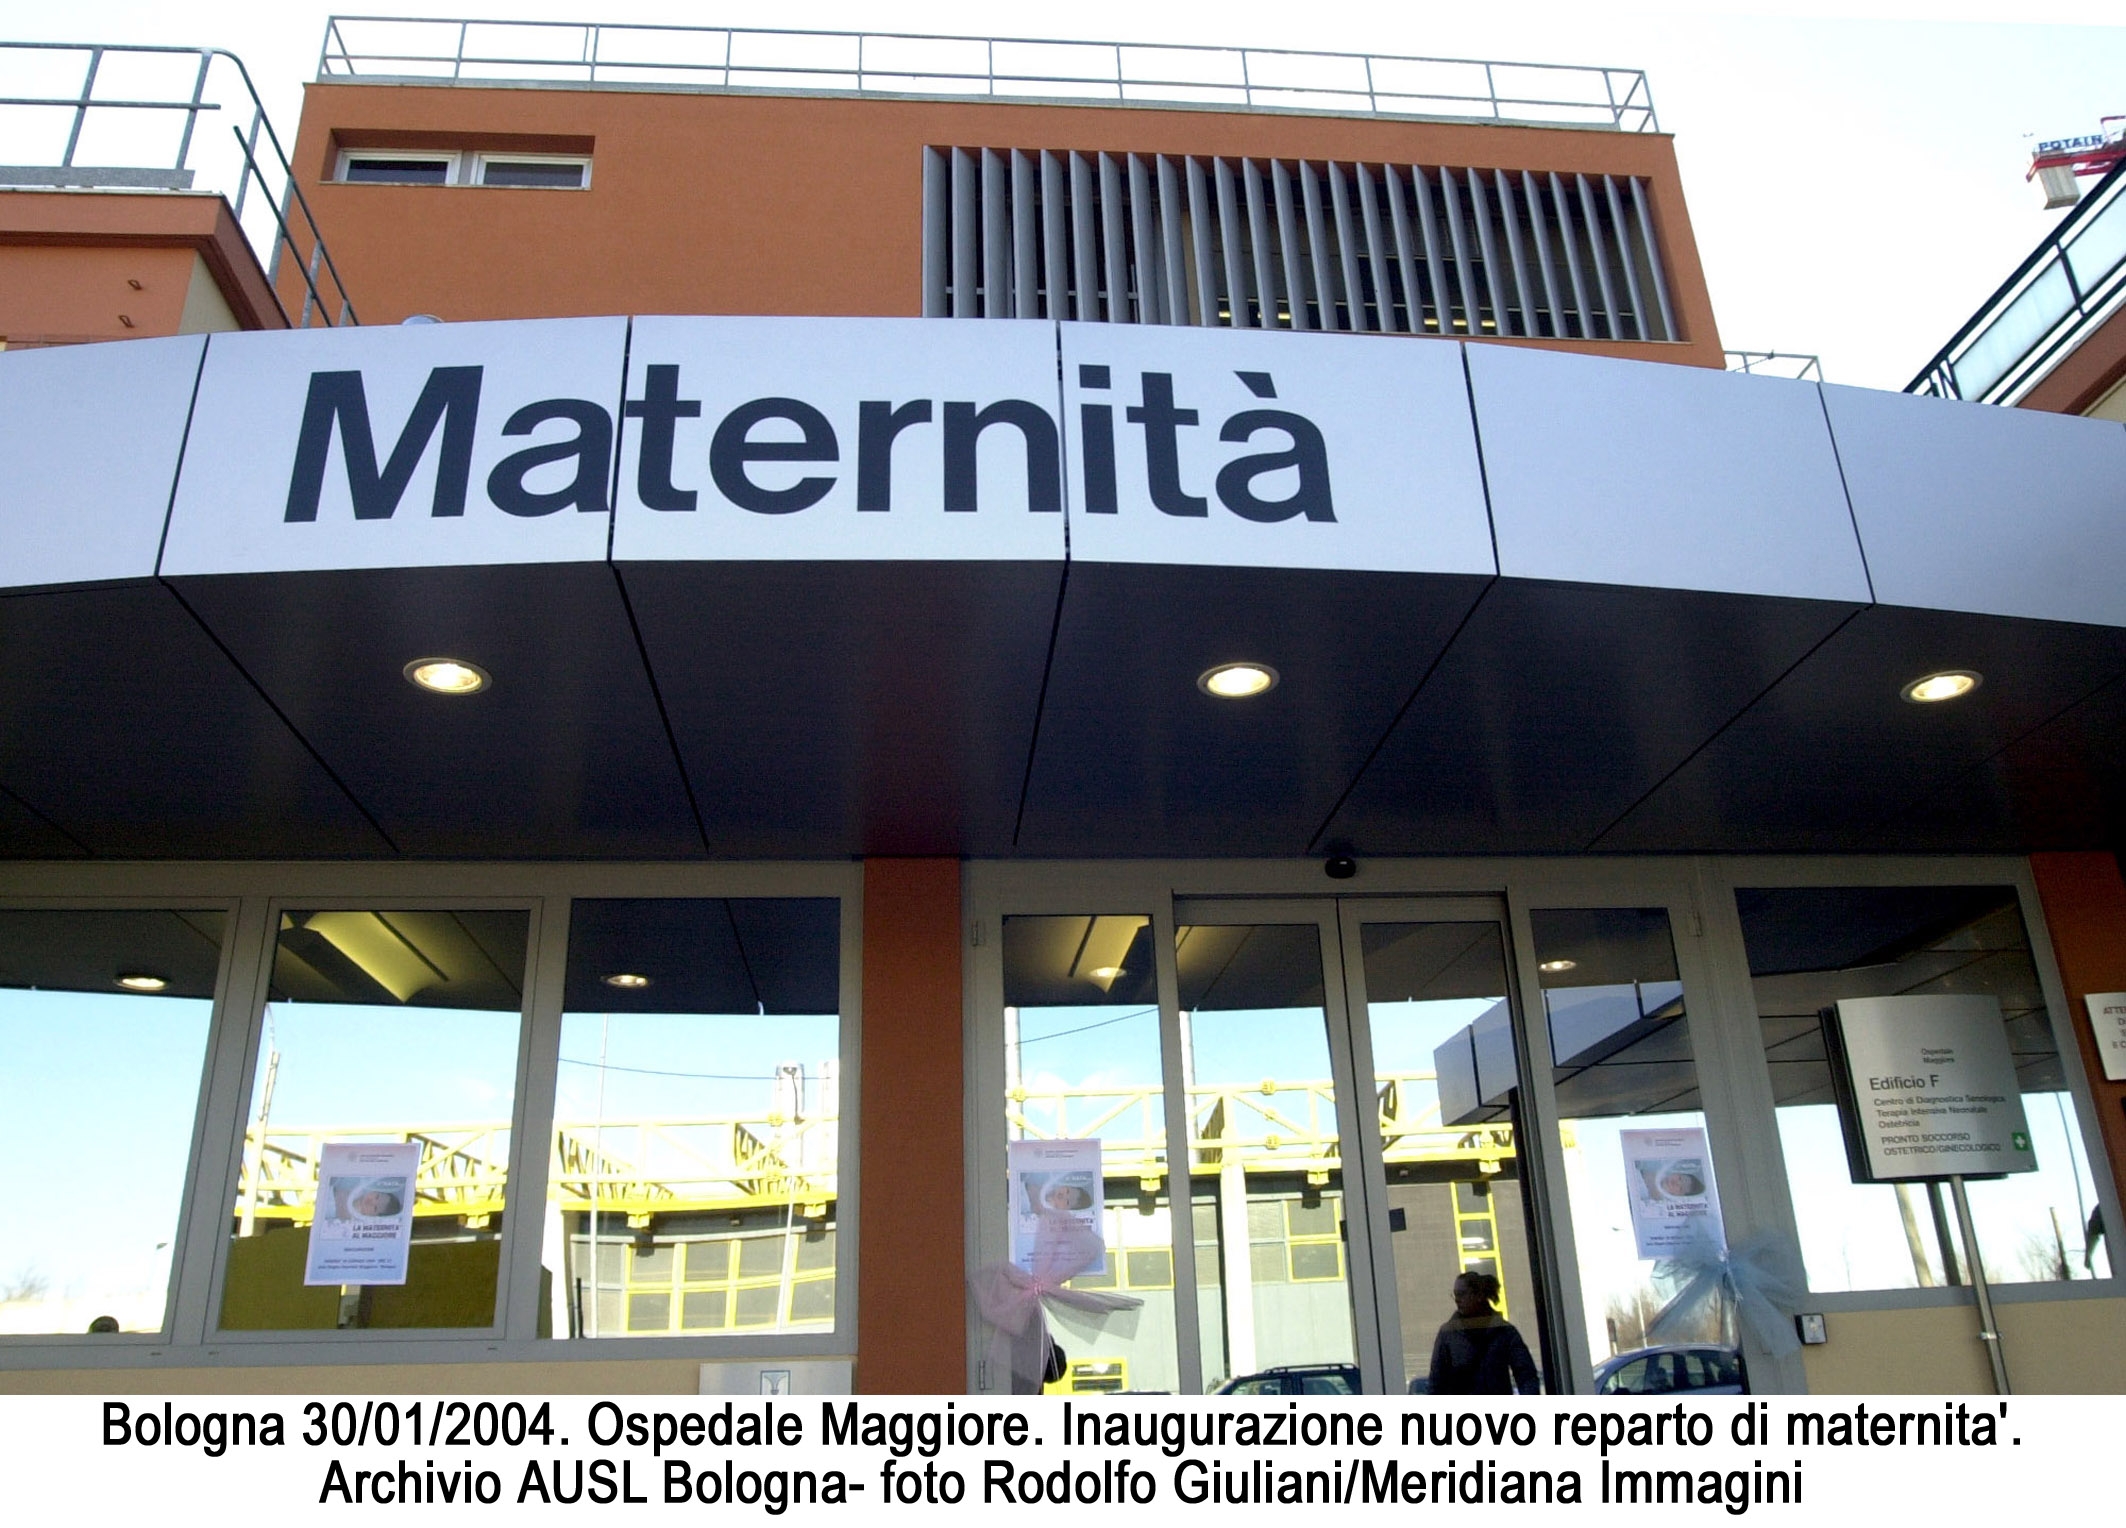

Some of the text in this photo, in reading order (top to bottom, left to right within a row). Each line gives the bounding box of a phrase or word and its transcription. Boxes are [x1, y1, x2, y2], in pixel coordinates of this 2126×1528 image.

[2039, 134, 2102, 152] POTAIN
[284, 363, 1338, 522] Maternità
[1869, 1074, 1939, 1090] Edificio F
[1874, 1098, 1904, 1106] Centro
[1906, 1096, 1914, 1104] di
[1916, 1095, 1963, 1105] Diagnostica
[1877, 1105, 1988, 1118] Terapia Intensiva Neonatale
[1878, 1120, 1920, 1129] Ostetricia
[1881, 1132, 1971, 1144] PRONTO SOCCORSO
[1884, 1143, 2001, 1156] OSTETRICO/GINECOLOGICO
